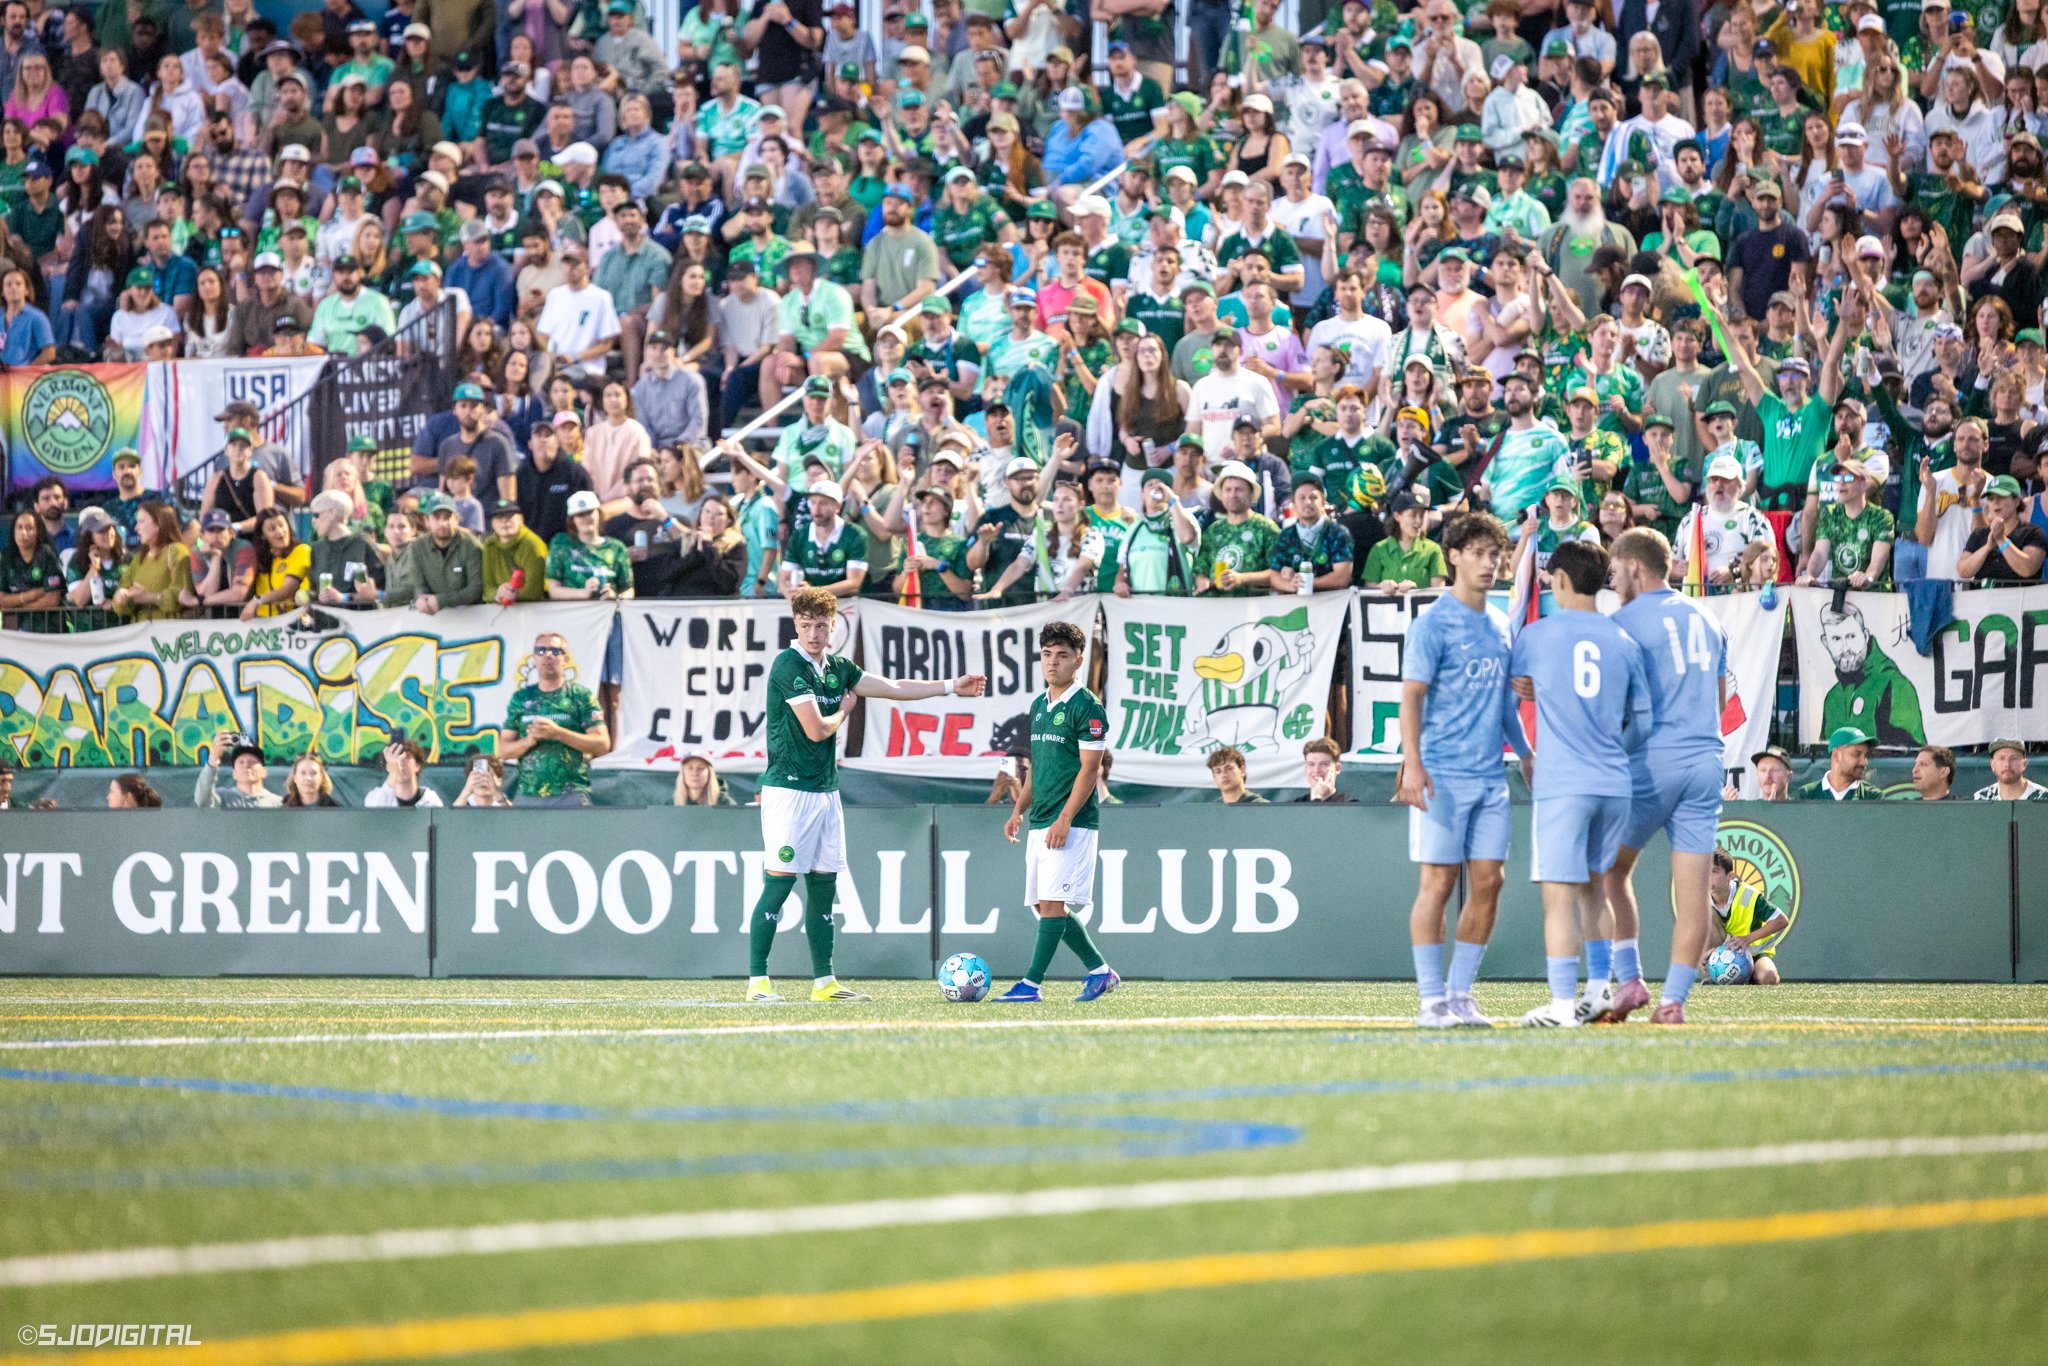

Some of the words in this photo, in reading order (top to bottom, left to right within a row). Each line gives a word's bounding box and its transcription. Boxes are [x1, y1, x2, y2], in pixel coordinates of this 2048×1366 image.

[33, 379, 104, 410] VERMONT
[230, 374, 286, 411] USA
[42, 440, 94, 462] GREEN
[151, 627, 283, 664] WELCOME
[1124, 621, 1187, 672] SET
[1662, 613, 1712, 675] 14
[687, 663, 764, 696] CUP
[1126, 668, 1178, 700] THE
[1573, 640, 1601, 698] 6
[648, 708, 766, 744] CLOW
[1114, 698, 1187, 756] TONE
[111, 851, 429, 935] GREEN
[1031, 848, 1300, 935] LUB
